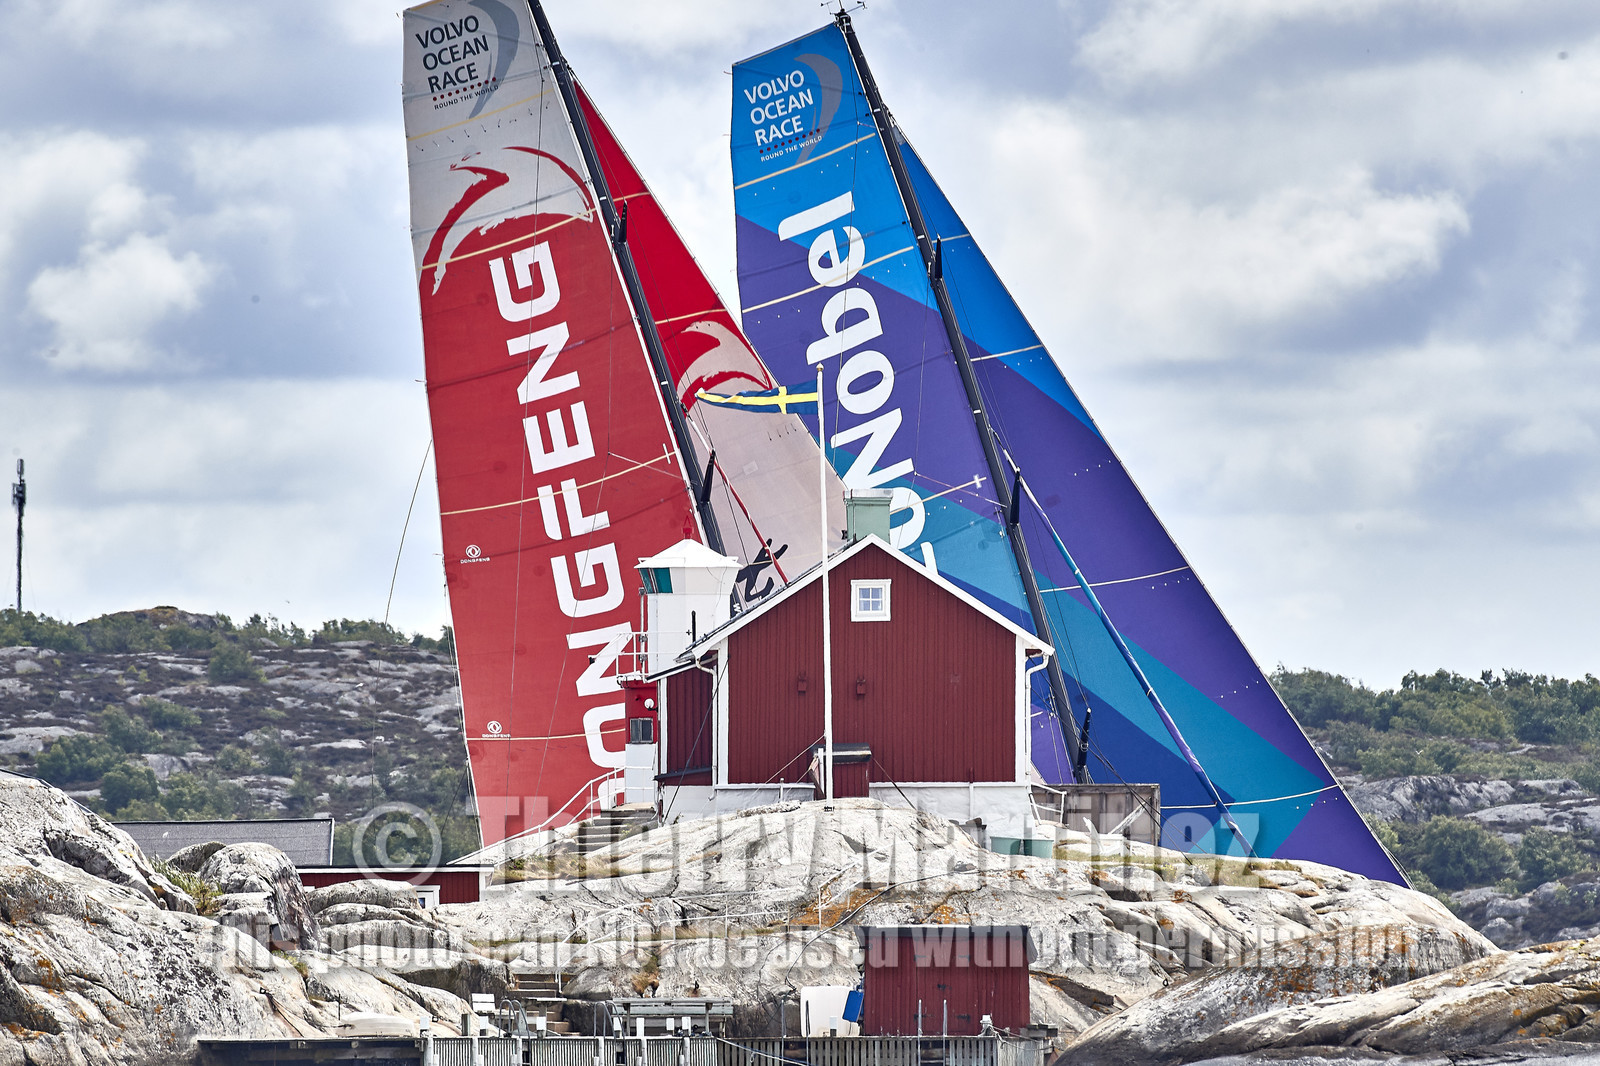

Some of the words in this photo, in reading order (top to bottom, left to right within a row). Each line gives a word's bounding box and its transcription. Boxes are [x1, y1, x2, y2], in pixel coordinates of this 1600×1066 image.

[415, 15, 479, 49] VOLVO
[422, 34, 489, 71] OCEAN
[427, 62, 479, 94] RACE
[744, 70, 805, 104] VOLVO
[434, 97, 458, 110] ROUND
[460, 93, 473, 103] THE
[475, 85, 499, 97] WORLD
[750, 88, 814, 125] OCEAN
[754, 115, 804, 146] RACE
[760, 150, 784, 162] ROUND
[785, 145, 798, 154] THE
[799, 135, 822, 149] WORLD
